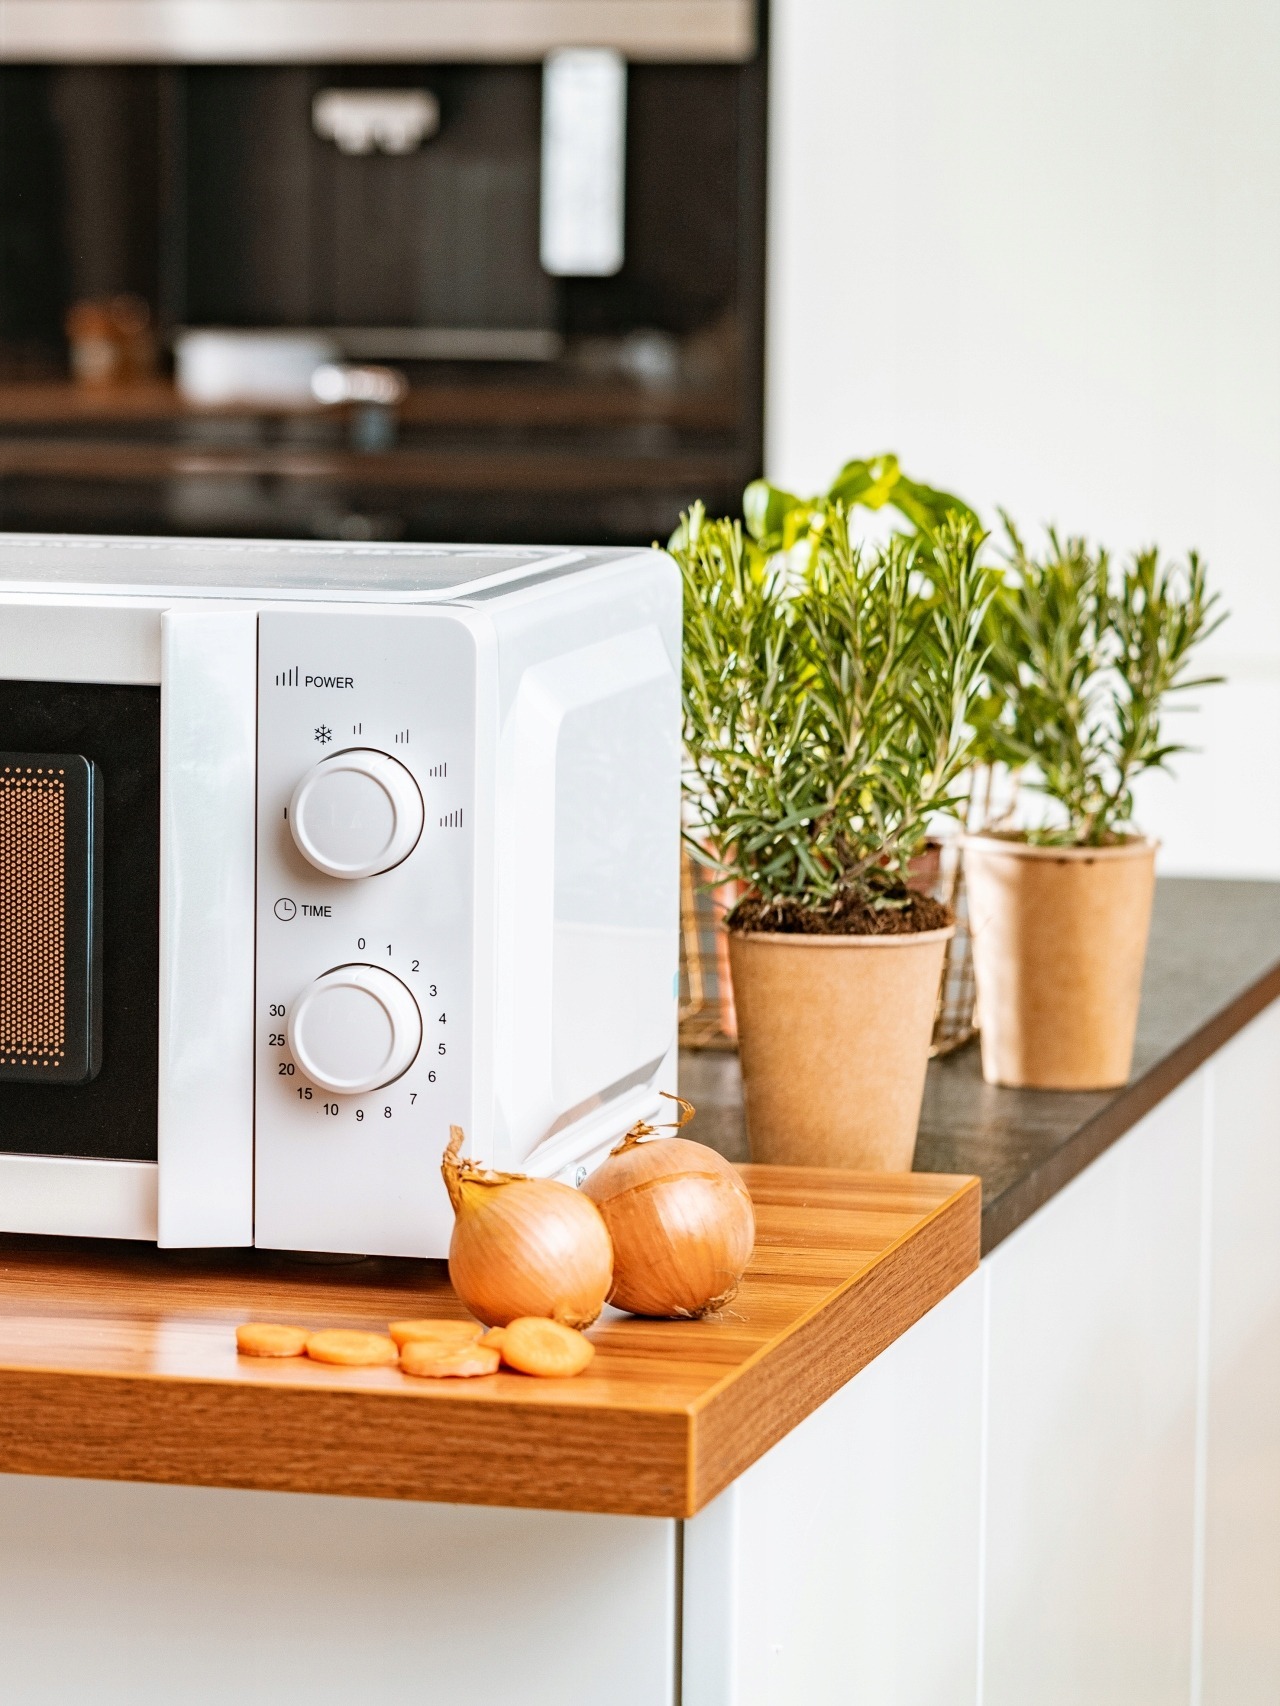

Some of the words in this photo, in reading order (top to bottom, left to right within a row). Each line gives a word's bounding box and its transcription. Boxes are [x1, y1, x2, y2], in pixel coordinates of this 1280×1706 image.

[304, 675, 354, 689] POWER
[300, 904, 332, 918] TIME
[357, 937, 366, 951] 0
[385, 944, 392, 957] 1
[411, 959, 420, 973] 2
[429, 984, 438, 997] 3
[269, 1003, 286, 1018] 30
[438, 1012, 447, 1025] 4
[268, 1033, 286, 1047] 25
[437, 1042, 447, 1056] 5
[278, 1062, 296, 1076] 20
[427, 1070, 437, 1083] 6
[296, 1086, 313, 1100] 15
[409, 1092, 418, 1106] 7
[323, 1102, 339, 1116] 10
[355, 1109, 365, 1122] 9
[383, 1105, 393, 1119] 8
